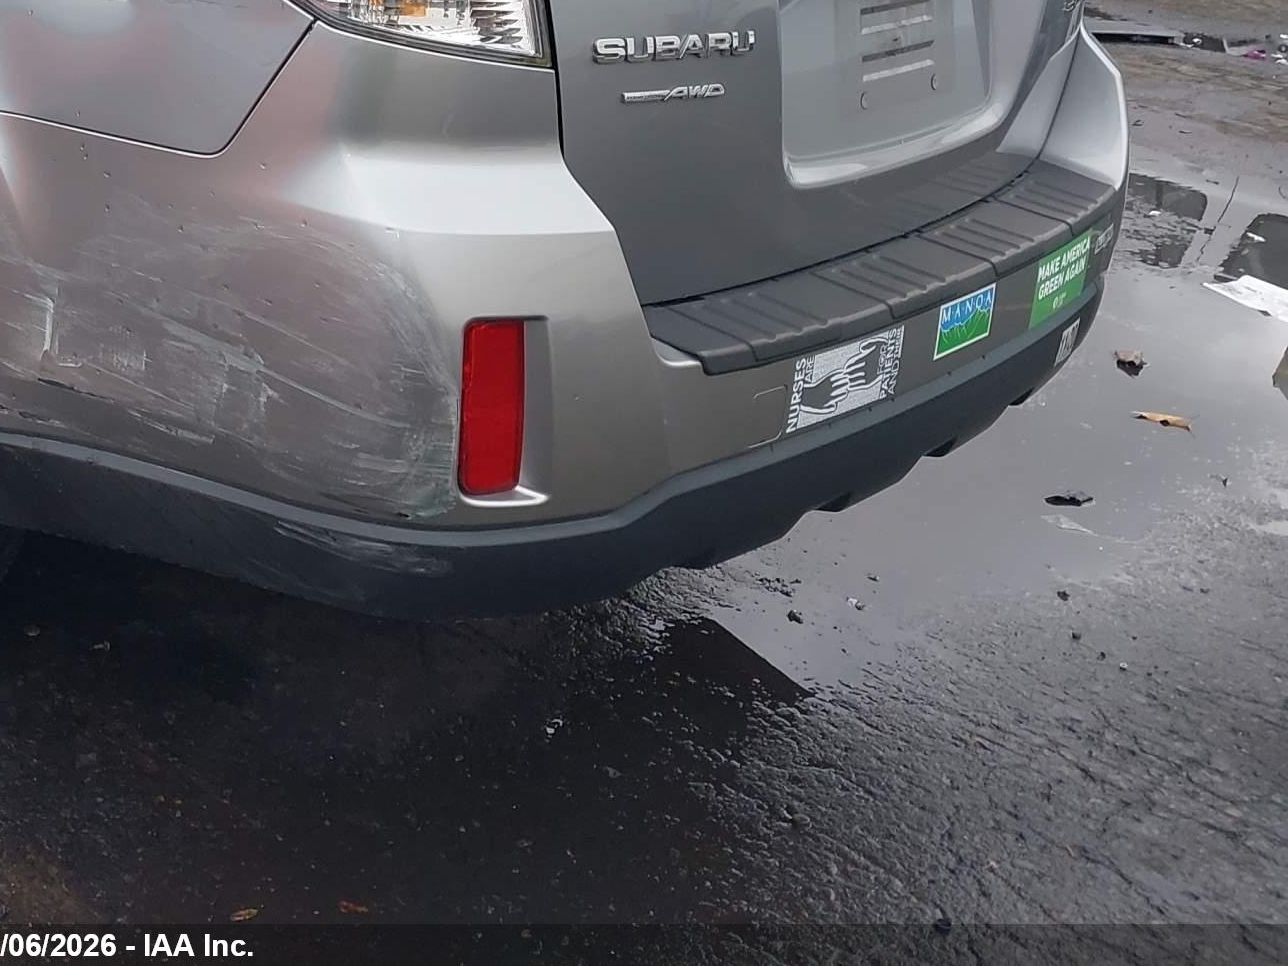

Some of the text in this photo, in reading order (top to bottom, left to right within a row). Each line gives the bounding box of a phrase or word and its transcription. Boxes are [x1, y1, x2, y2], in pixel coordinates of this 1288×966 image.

[593, 30, 755, 64] SUBARU
[663, 83, 725, 101] AWD
[1037, 256, 1061, 283] MAKE
[1060, 236, 1090, 270] AMERICA
[1038, 271, 1064, 301] GREEN
[1064, 255, 1087, 285] AGAIN
[804, 356, 815, 383] ARE
[877, 344, 888, 375] FOR
[879, 328, 897, 399] PATIENTS
[887, 359, 900, 395] AND
[786, 357, 806, 433] NURSES
